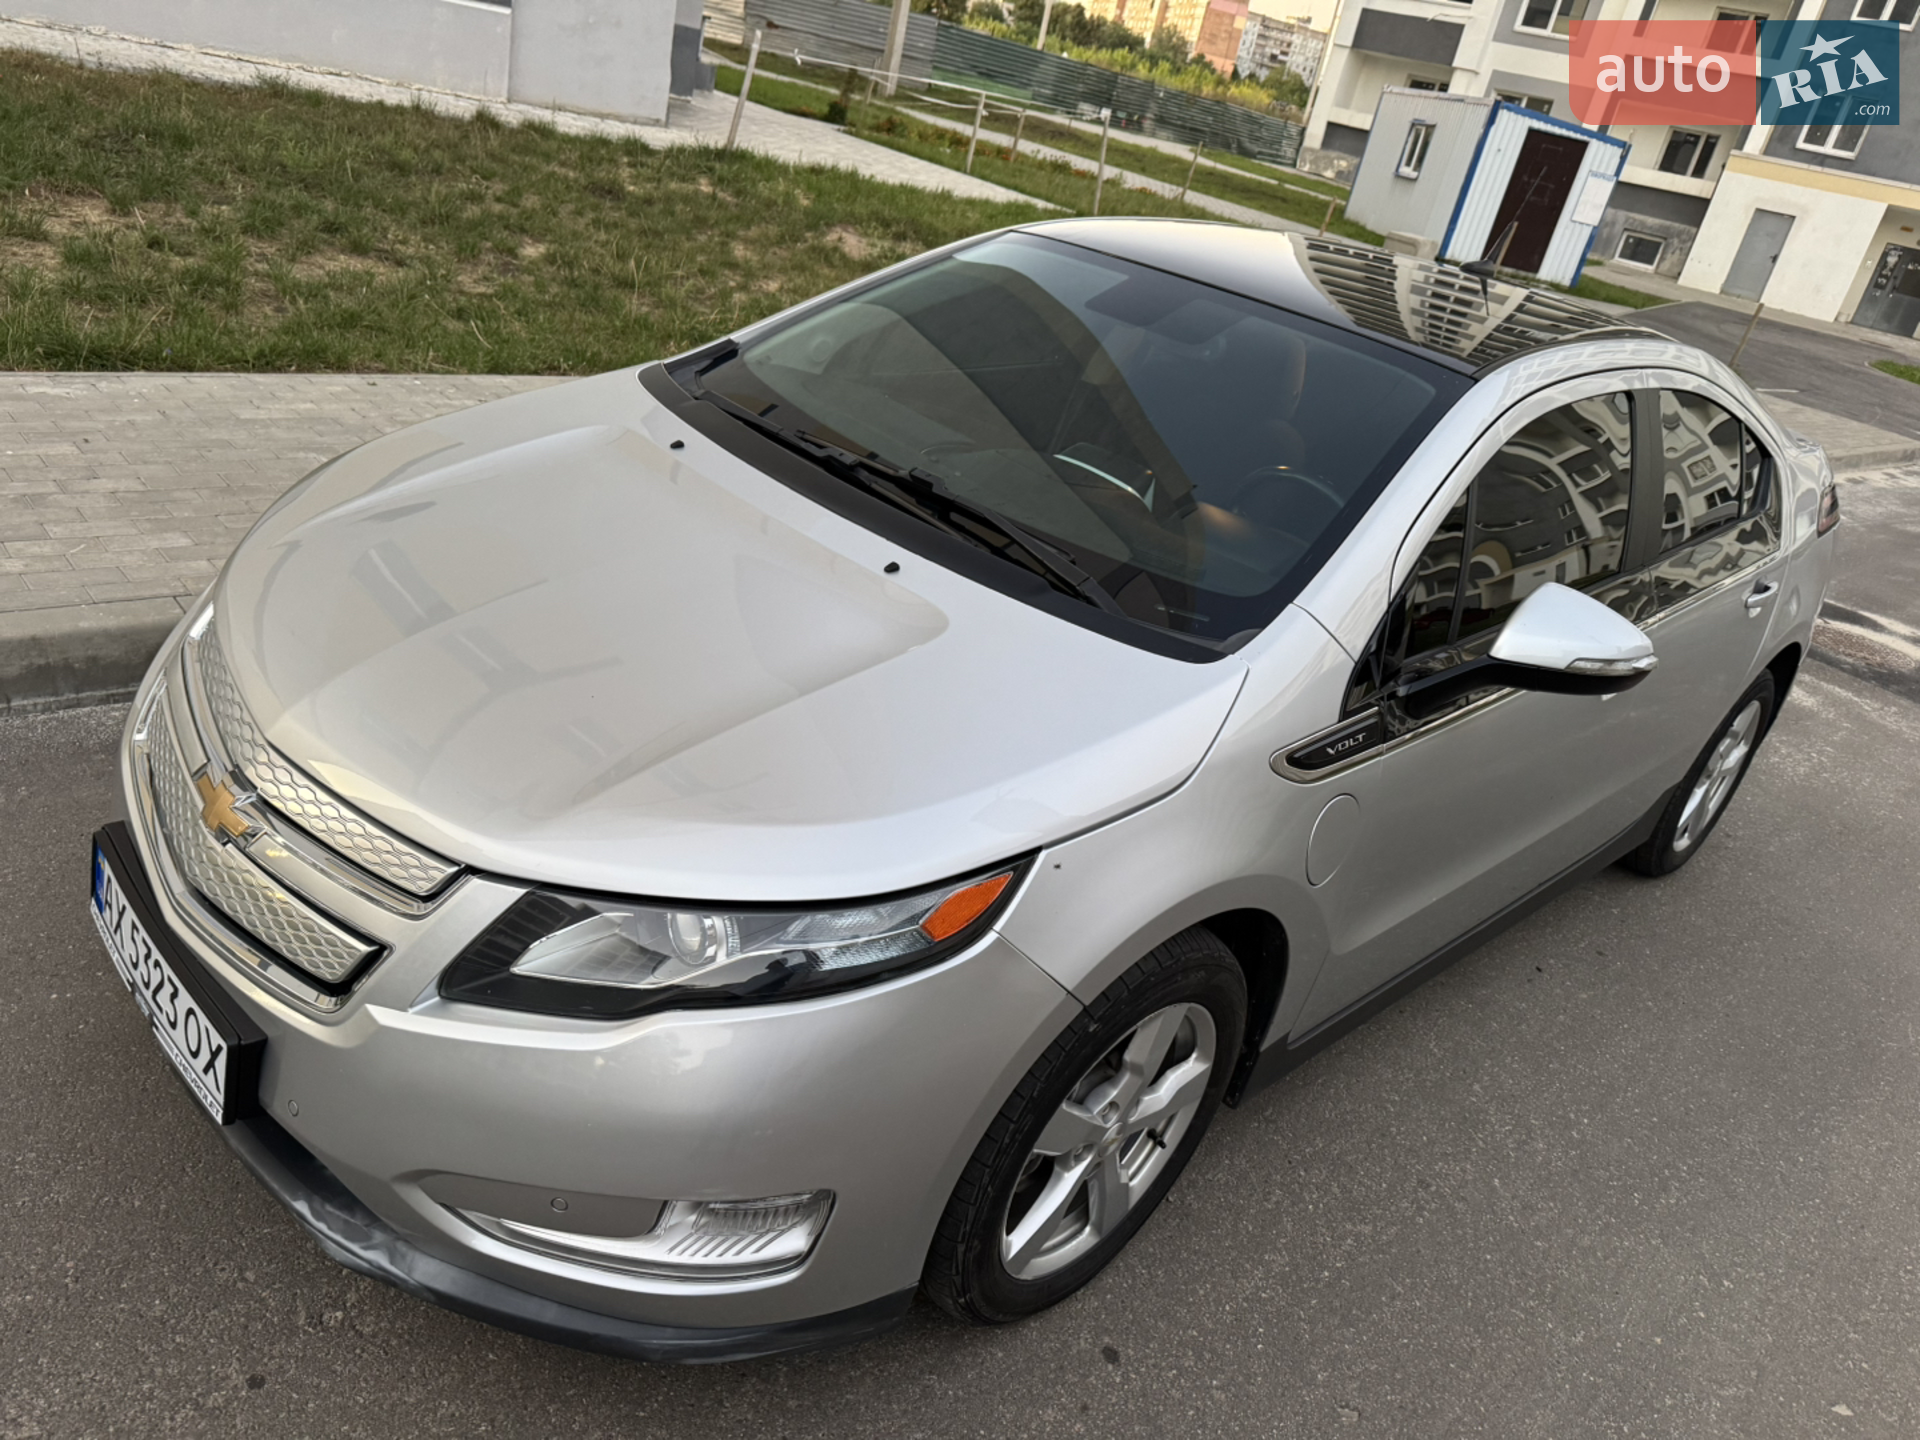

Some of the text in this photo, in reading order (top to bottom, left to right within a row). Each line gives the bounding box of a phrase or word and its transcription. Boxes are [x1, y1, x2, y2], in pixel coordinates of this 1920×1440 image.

[1325, 732, 1366, 756] VOLT
[103, 872, 126, 952] AX
[128, 922, 180, 1032] 5323
[184, 1006, 224, 1096] OX
